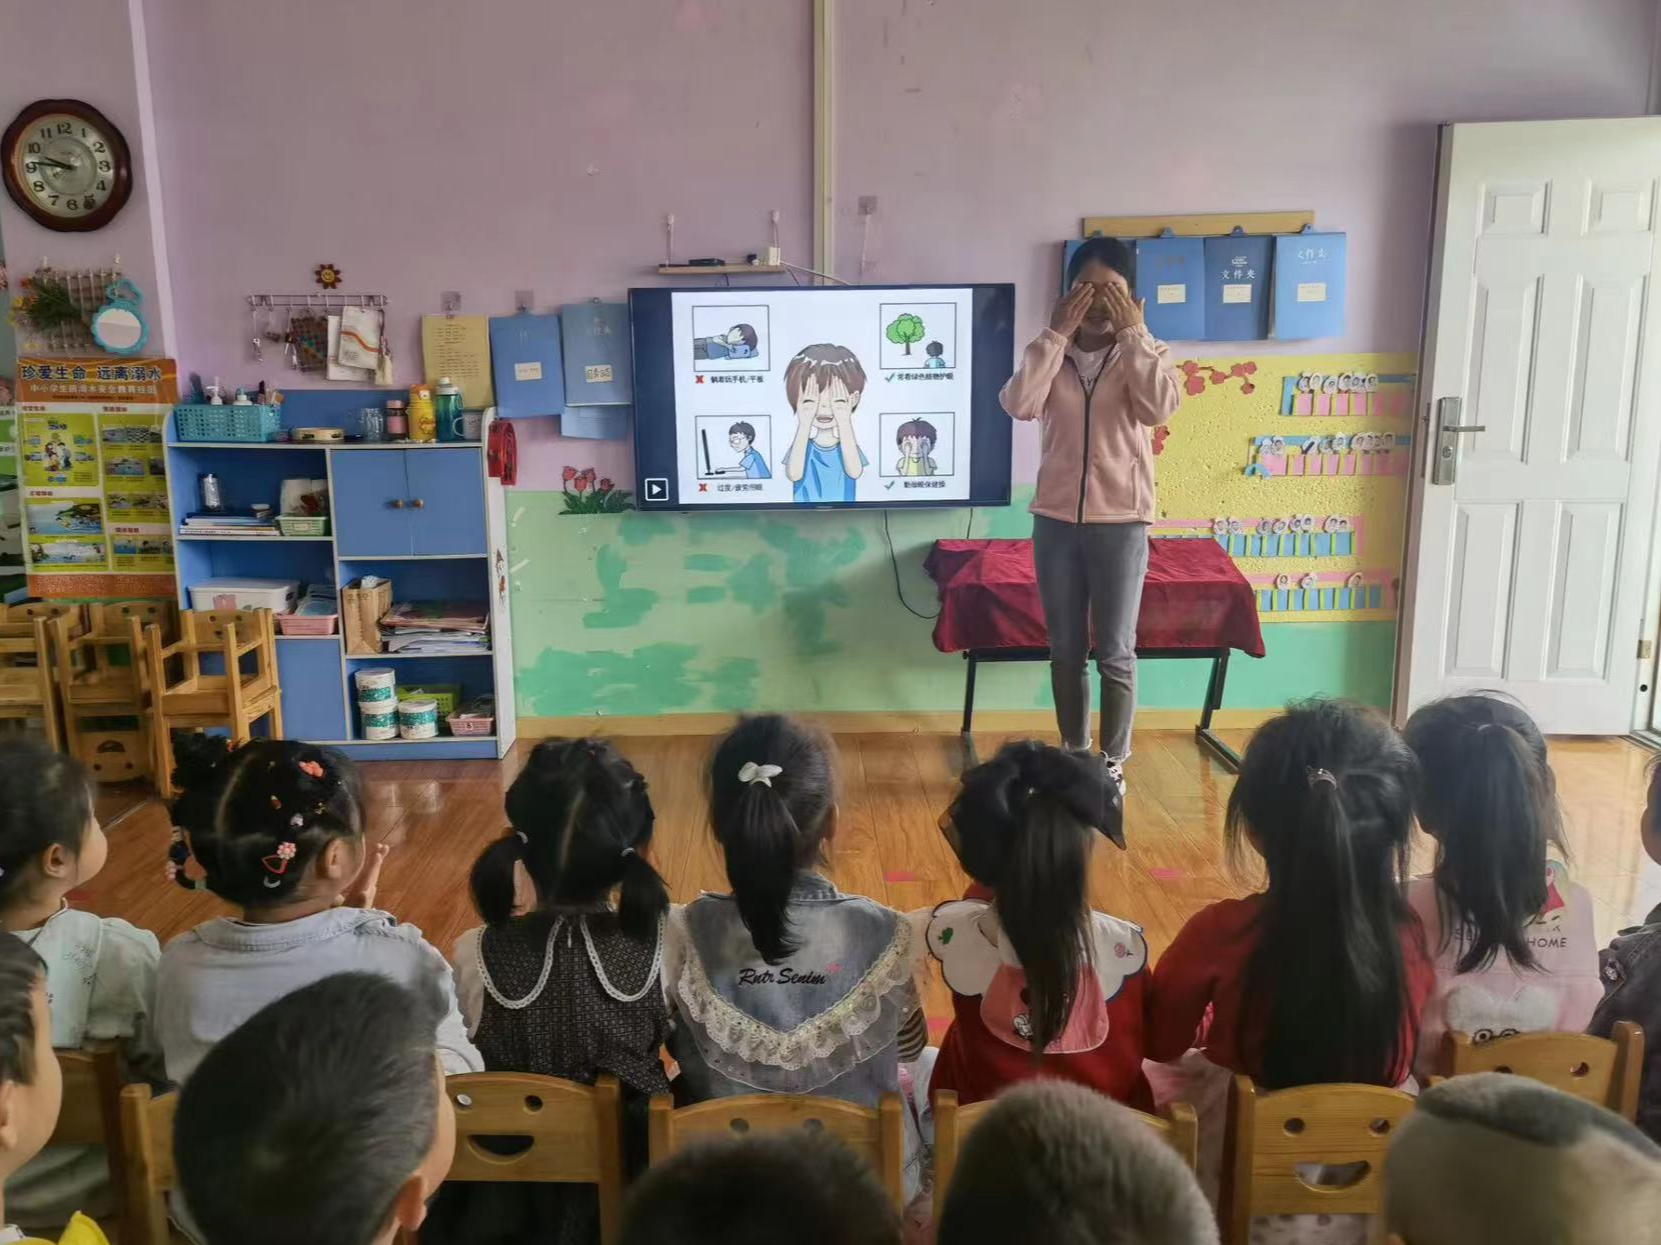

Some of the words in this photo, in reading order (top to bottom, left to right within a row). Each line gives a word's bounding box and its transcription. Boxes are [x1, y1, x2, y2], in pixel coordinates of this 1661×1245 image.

[41, 127, 52, 139] 11
[57, 122, 72, 135] 12
[81, 128, 87, 138] 1
[28, 142, 41, 154] 10
[93, 142, 106, 153] 2
[26, 161, 37, 173] 9
[99, 160, 111, 172] 3
[33, 181, 45, 192] 8
[96, 180, 106, 191] 4
[48, 194, 59, 206] 7
[66, 199, 78, 210] 6
[1221, 269, 1256, 280] 文件夹
[21, 365, 87, 381] 珍爱生命
[97, 366, 162, 381] 远离溺水
[1527, 937, 1567, 948] HOME
